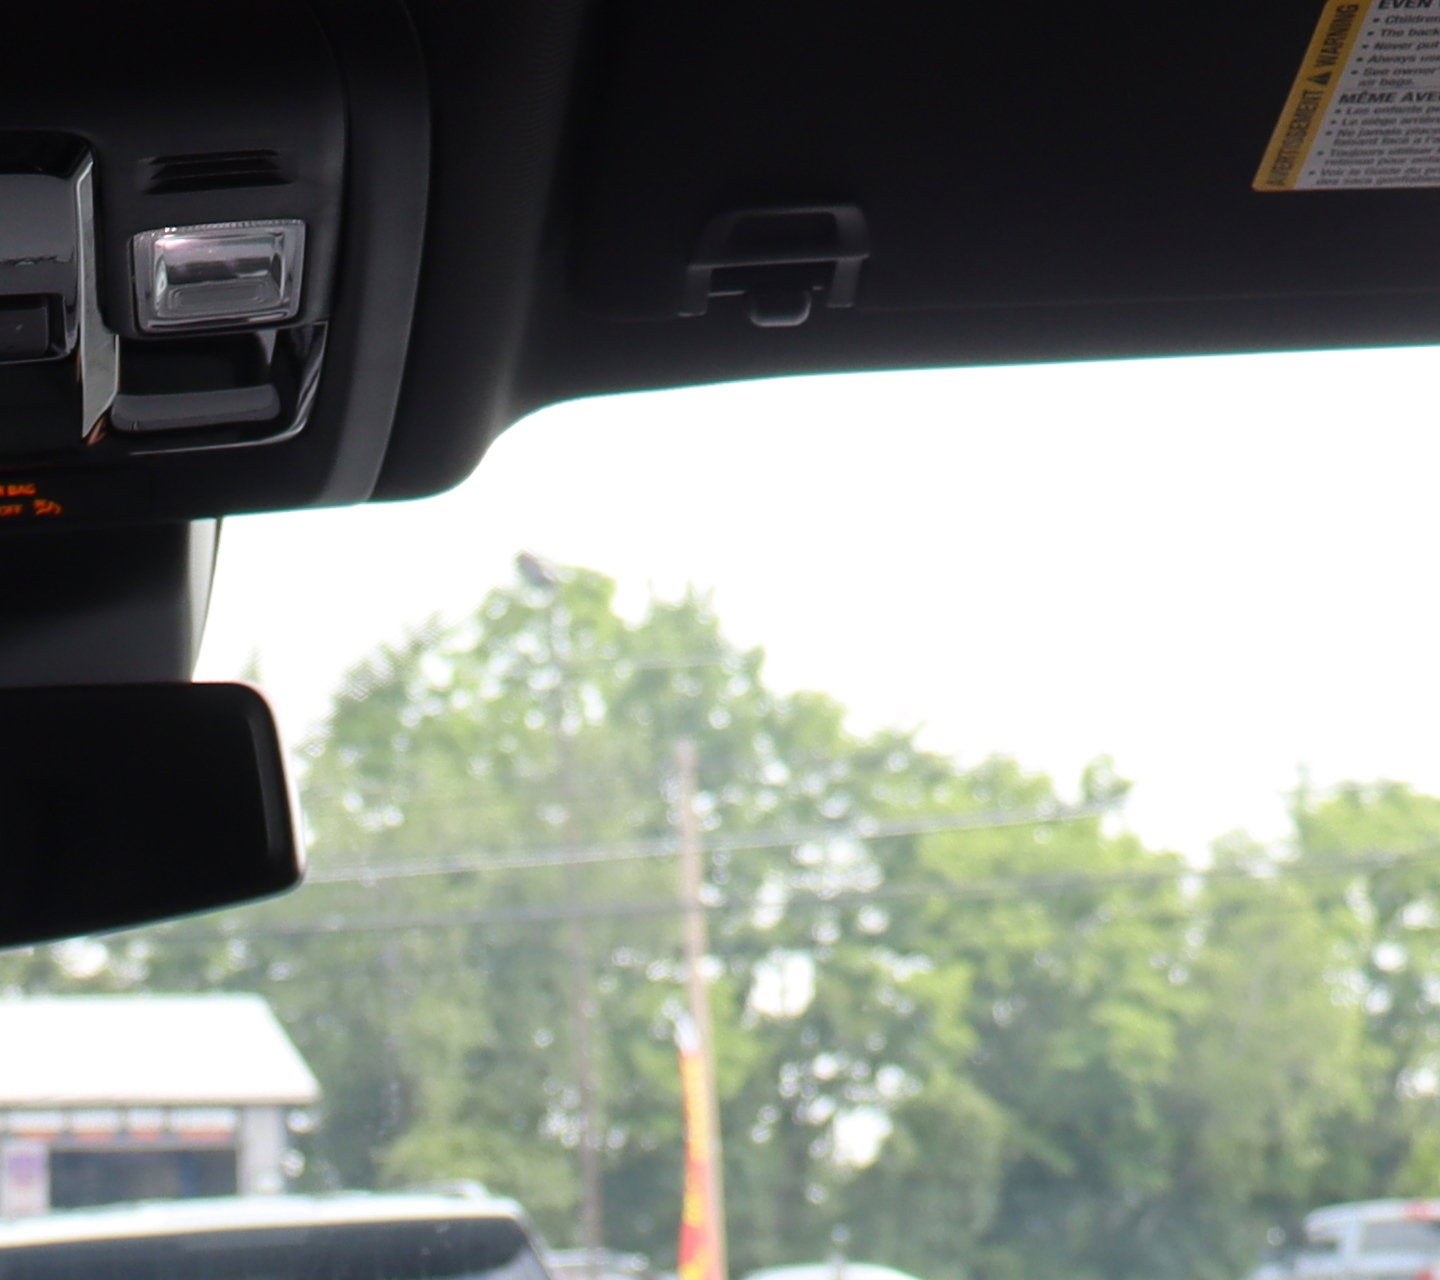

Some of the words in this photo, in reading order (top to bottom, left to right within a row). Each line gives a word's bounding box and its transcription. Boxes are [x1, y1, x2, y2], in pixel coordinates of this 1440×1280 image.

[1312, 3, 1361, 67] WARNING
[1336, 90, 1400, 103] MÊME
[7, 483, 37, 497] BAG
